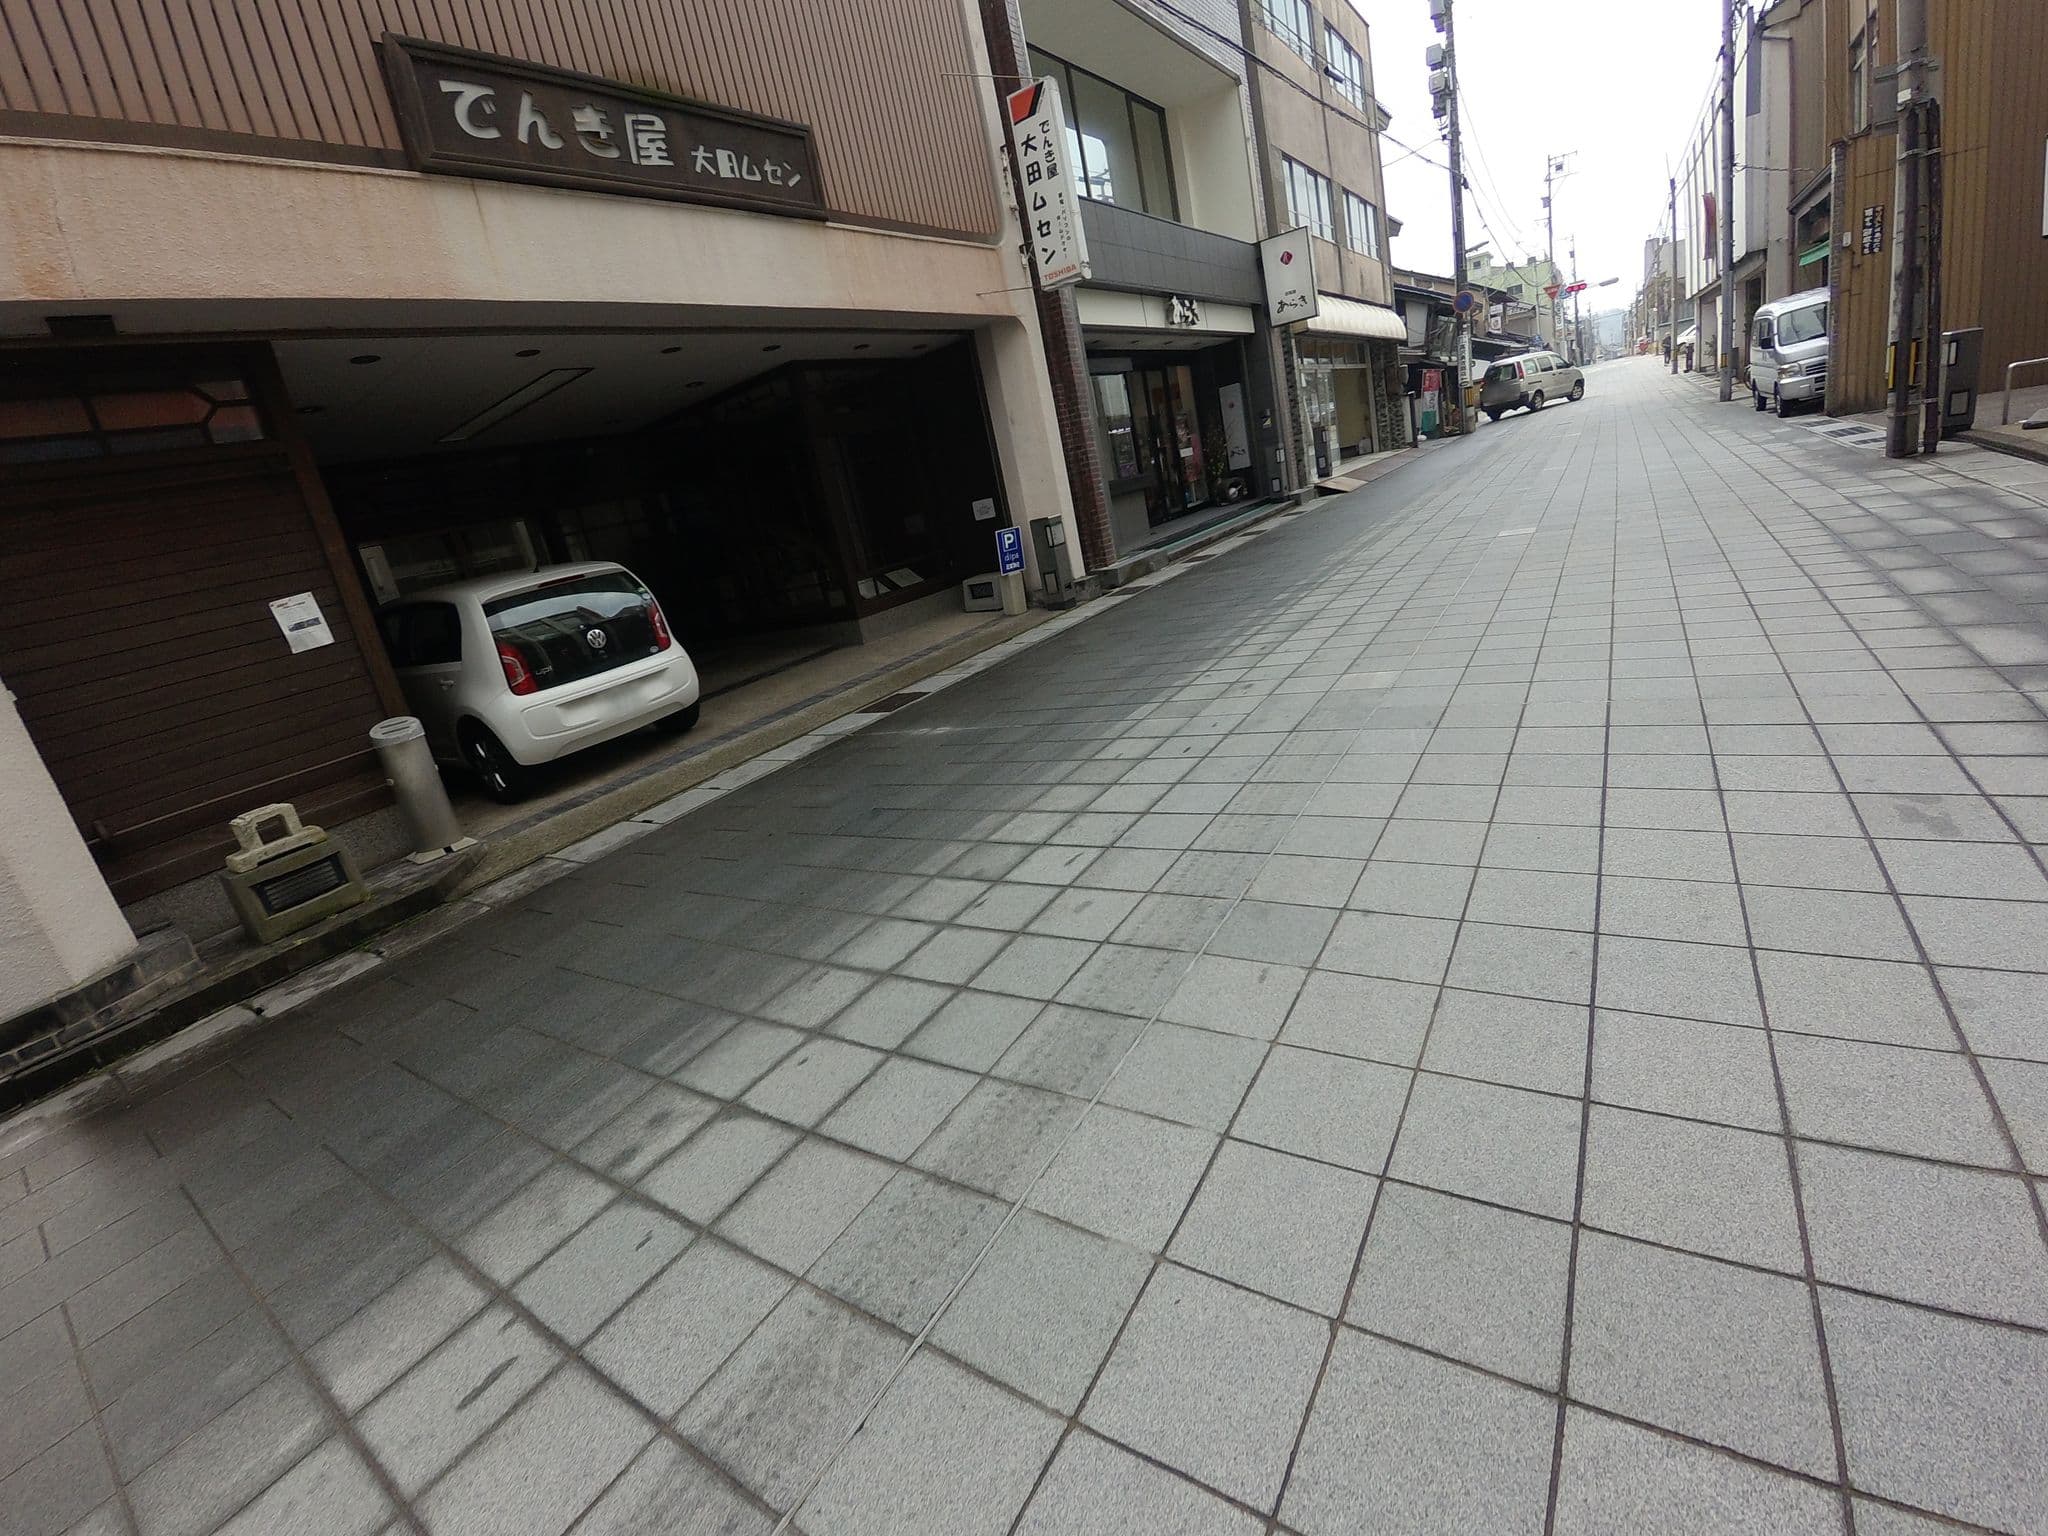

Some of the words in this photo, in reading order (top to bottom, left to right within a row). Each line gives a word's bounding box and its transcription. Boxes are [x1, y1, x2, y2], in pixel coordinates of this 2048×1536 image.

[438, 79, 675, 168] でんき屋
[1039, 118, 1059, 181] でんき屋
[1021, 133, 1056, 265] 大田ムセン
[1044, 264, 1077, 281] TOSHIBA
[1276, 294, 1308, 314] あらき
[1004, 534, 1014, 549] P
